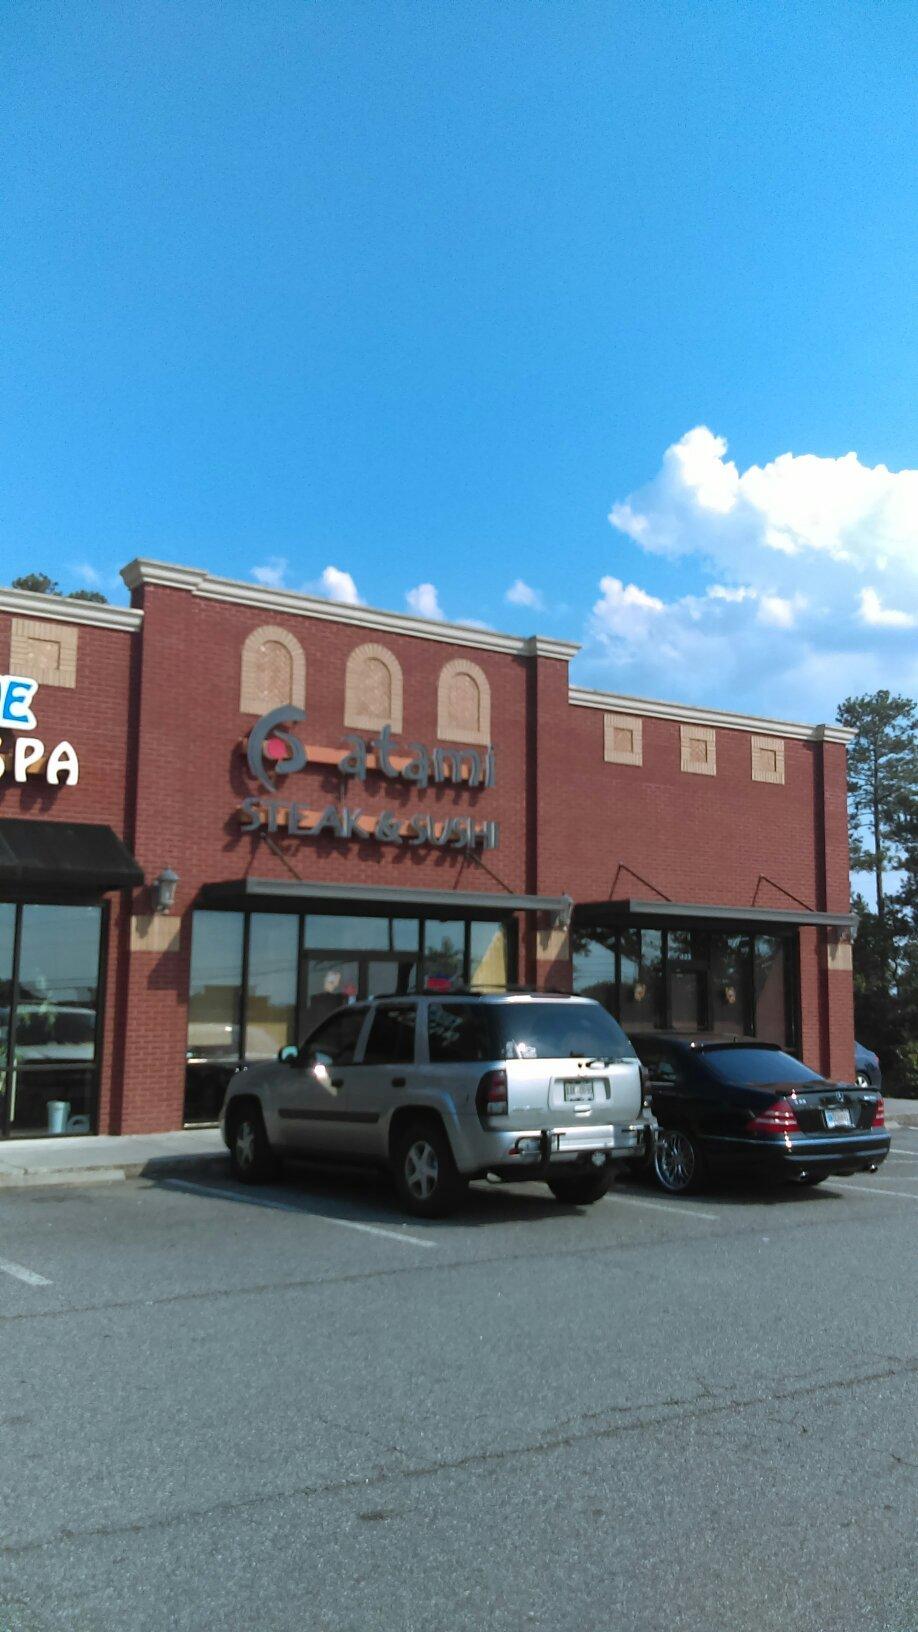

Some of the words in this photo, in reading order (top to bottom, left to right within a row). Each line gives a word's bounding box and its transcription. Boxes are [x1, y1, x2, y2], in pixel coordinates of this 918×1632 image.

[0, 675, 39, 730] E
[0, 737, 79, 786] PA
[240, 797, 369, 839] STEAK
[375, 810, 403, 844] &
[409, 813, 499, 849] SUSHI
